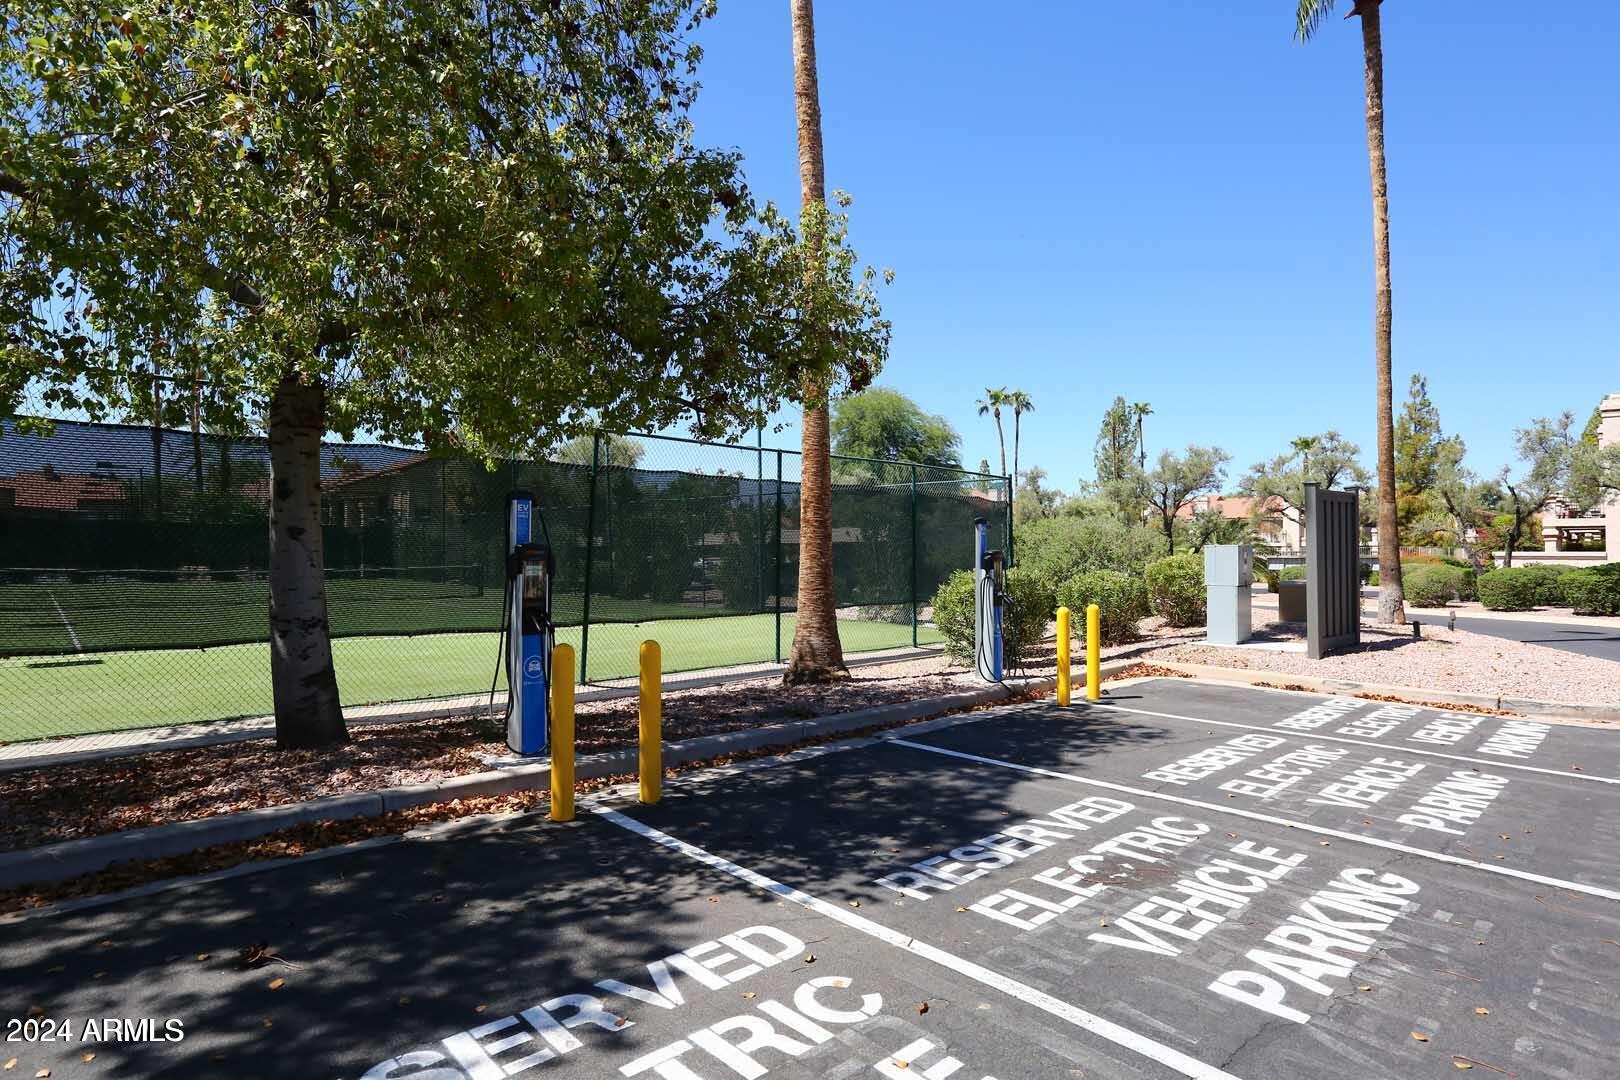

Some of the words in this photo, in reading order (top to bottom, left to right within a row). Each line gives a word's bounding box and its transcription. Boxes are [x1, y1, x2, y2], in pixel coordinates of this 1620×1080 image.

[1141, 733, 1288, 785] RESERVED
[1406, 713, 1486, 745] VEHICLE
[1476, 721, 1552, 758] PARKING
[1217, 744, 1350, 799] ELECTRIC
[1306, 756, 1428, 809] VEHICLE
[1396, 770, 1511, 836] PARKING
[873, 796, 1137, 901] RESERVED
[967, 816, 1212, 930] ELECTRIC
[1087, 840, 1309, 956] VEHICLE
[1207, 868, 1421, 1024] PARKING
